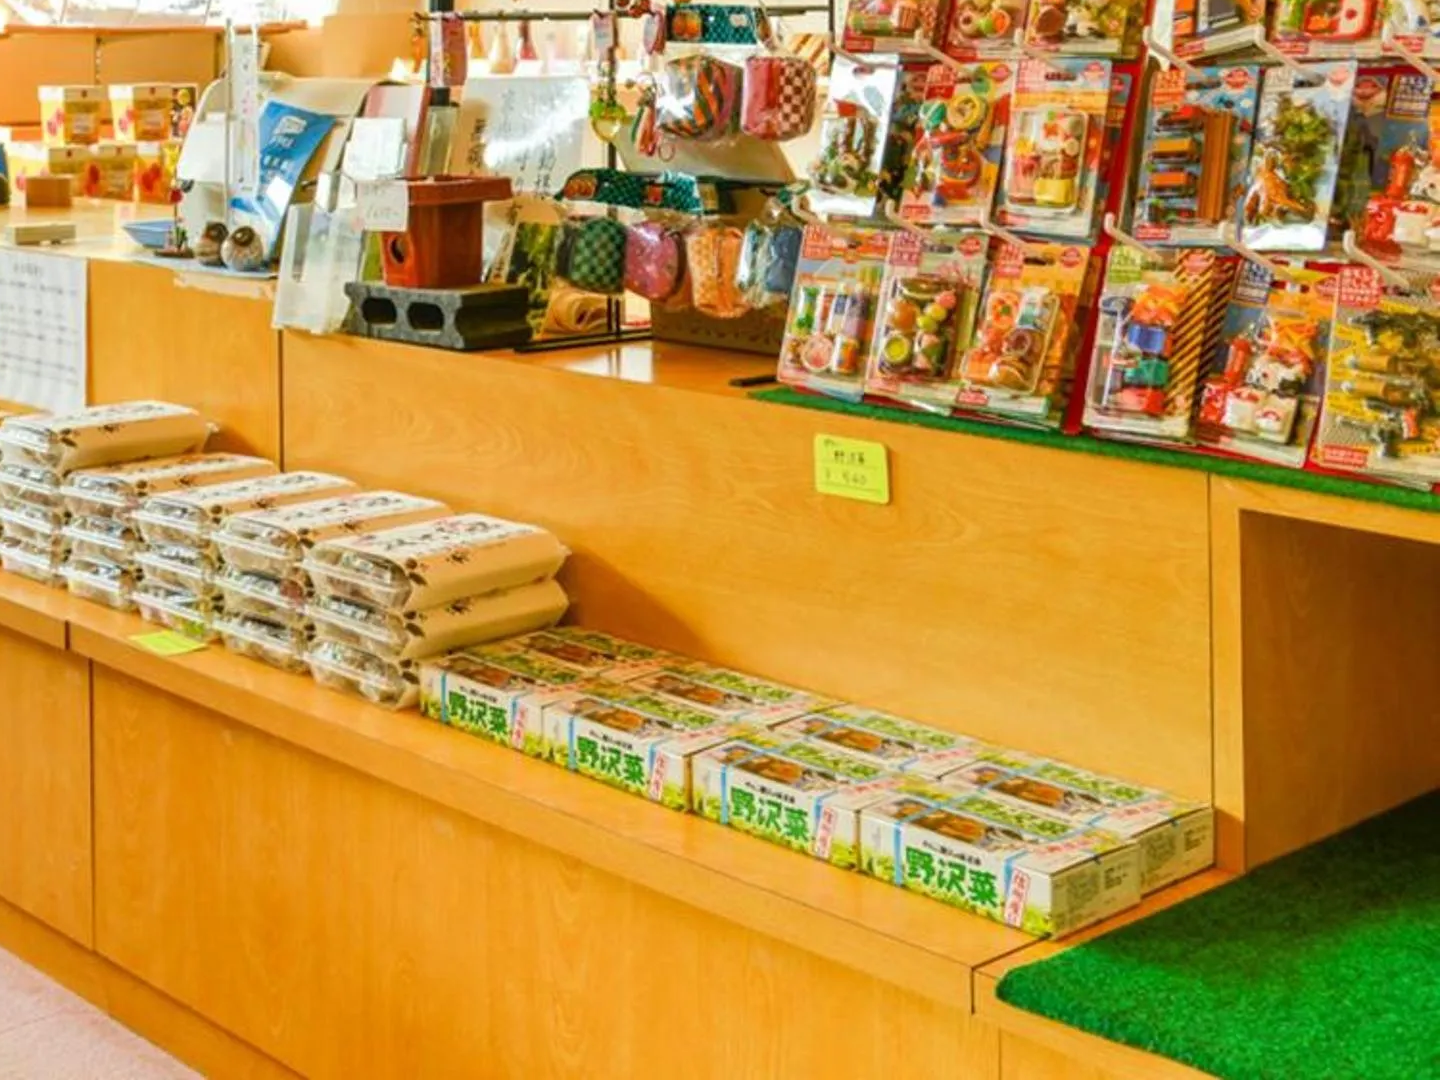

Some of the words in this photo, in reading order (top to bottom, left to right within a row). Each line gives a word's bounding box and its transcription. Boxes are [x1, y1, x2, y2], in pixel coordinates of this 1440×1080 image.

[448, 690, 508, 734] 野沢菜
[576, 735, 646, 785] 野沢菜
[730, 786, 810, 842] 野沢菜
[905, 845, 999, 909] 野沢菜
